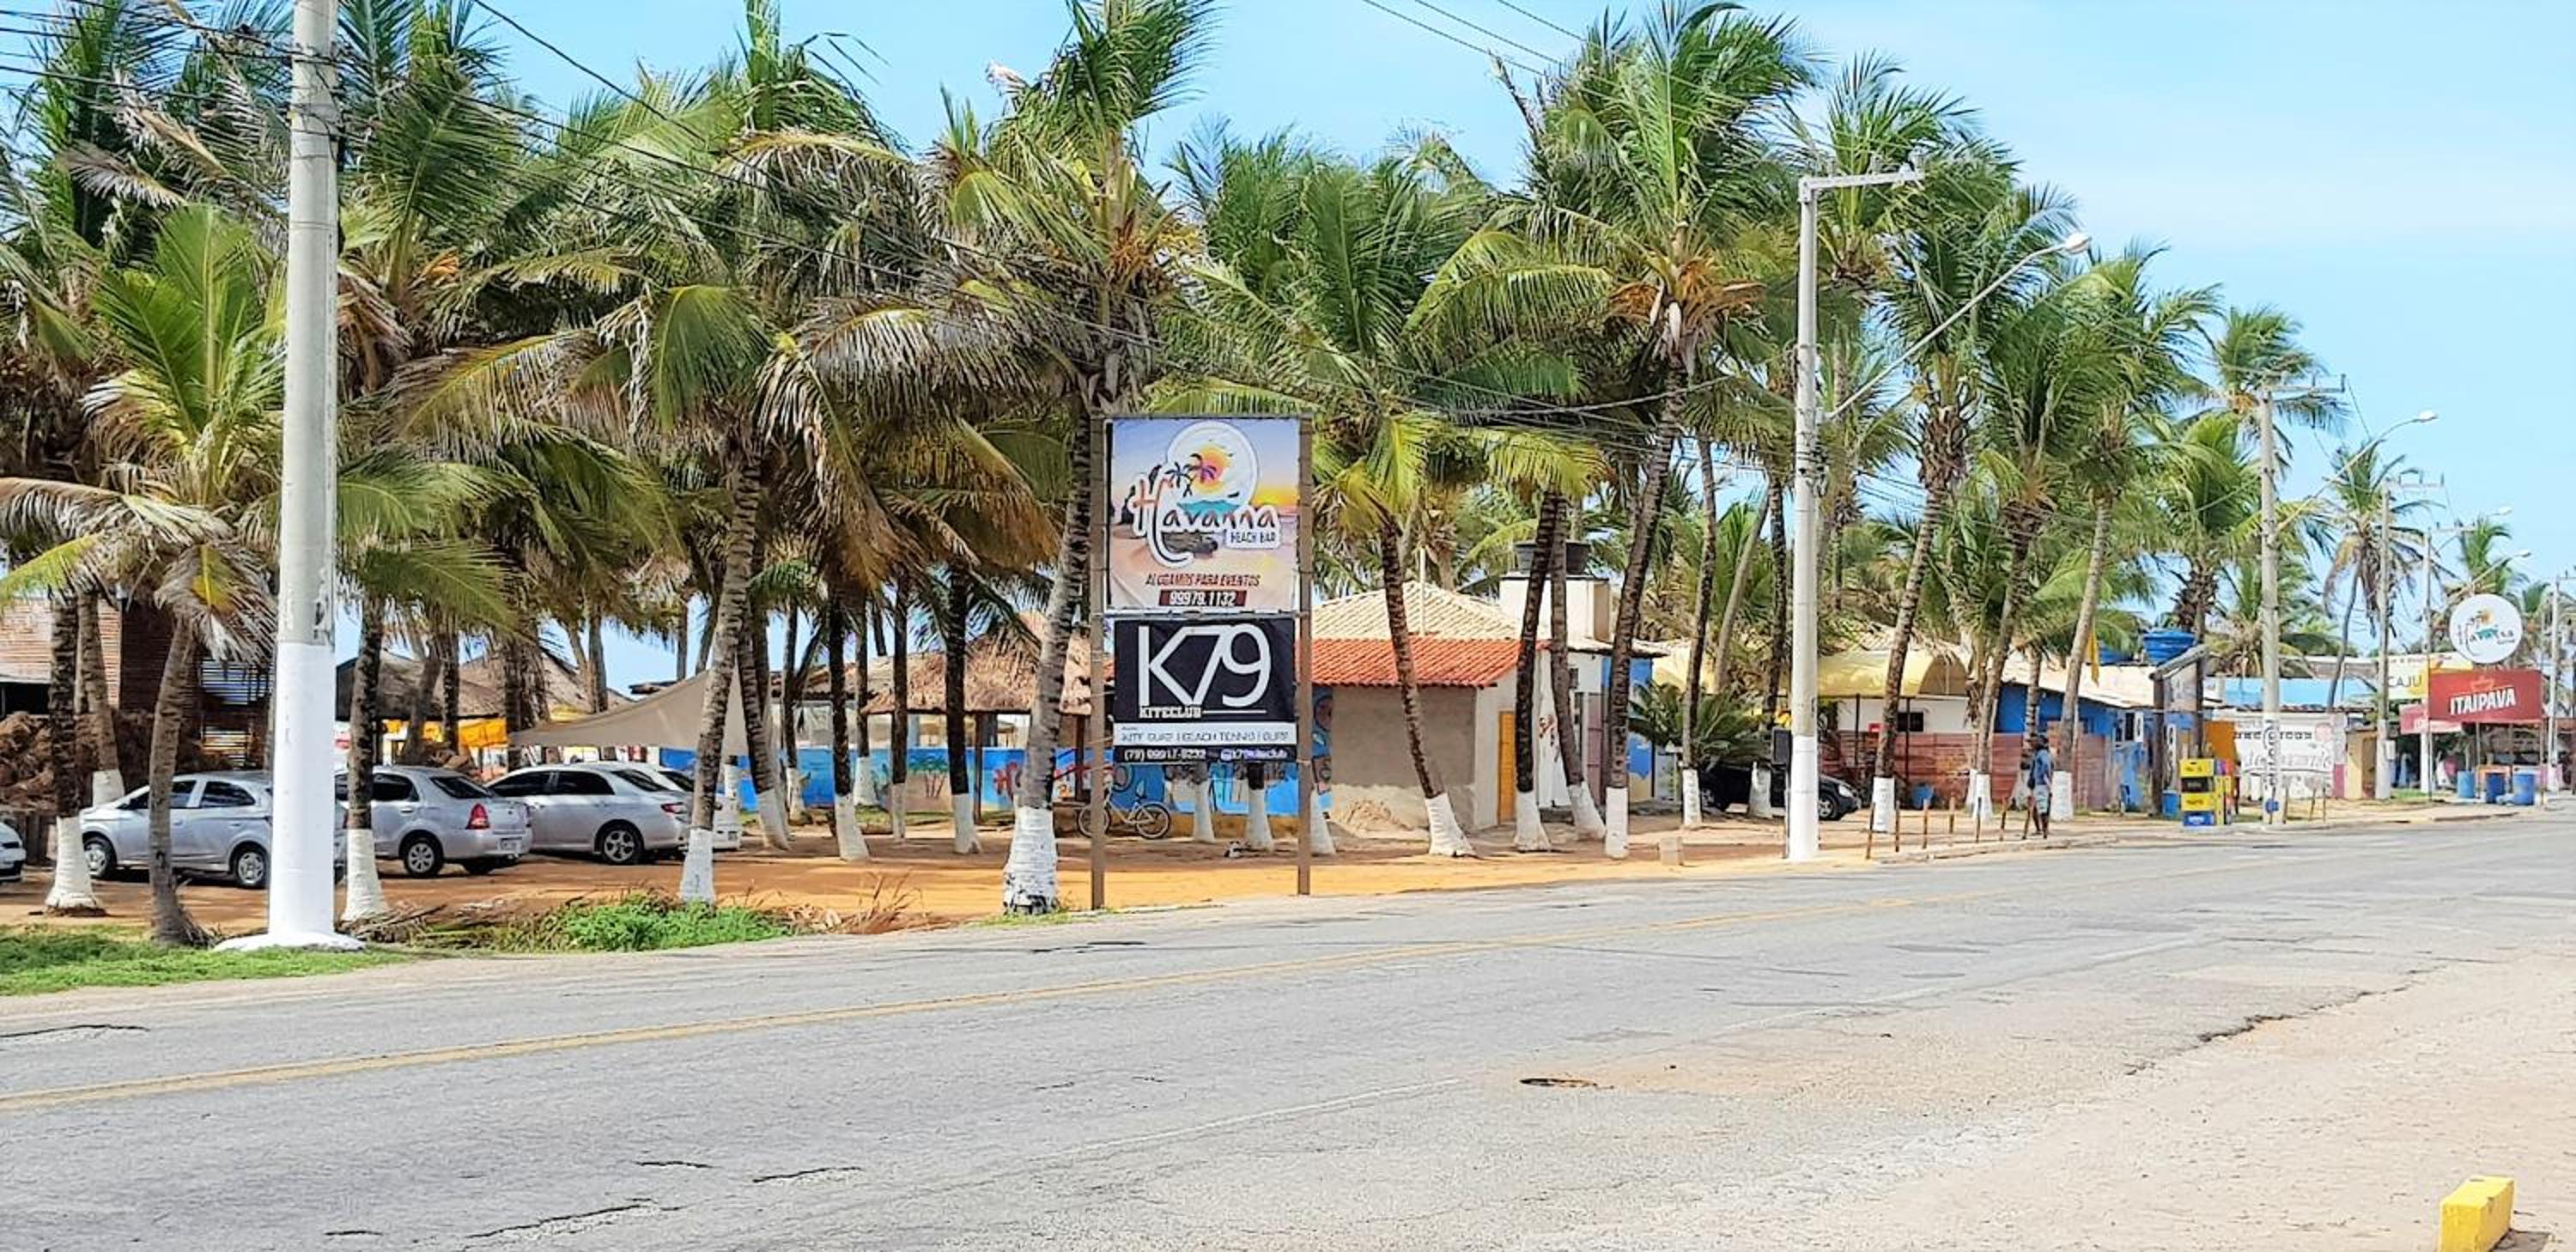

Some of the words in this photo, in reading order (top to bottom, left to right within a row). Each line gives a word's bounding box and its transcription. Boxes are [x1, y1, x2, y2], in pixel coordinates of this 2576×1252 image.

[1260, 531, 1276, 544] BAR
[1195, 574, 1218, 586] PARA
[1219, 574, 1261, 586] EVENTOS
[1138, 623, 1272, 708] K79
[2450, 688, 2517, 715] ITAIPAVA
[1139, 707, 1201, 719] KITECLUB
